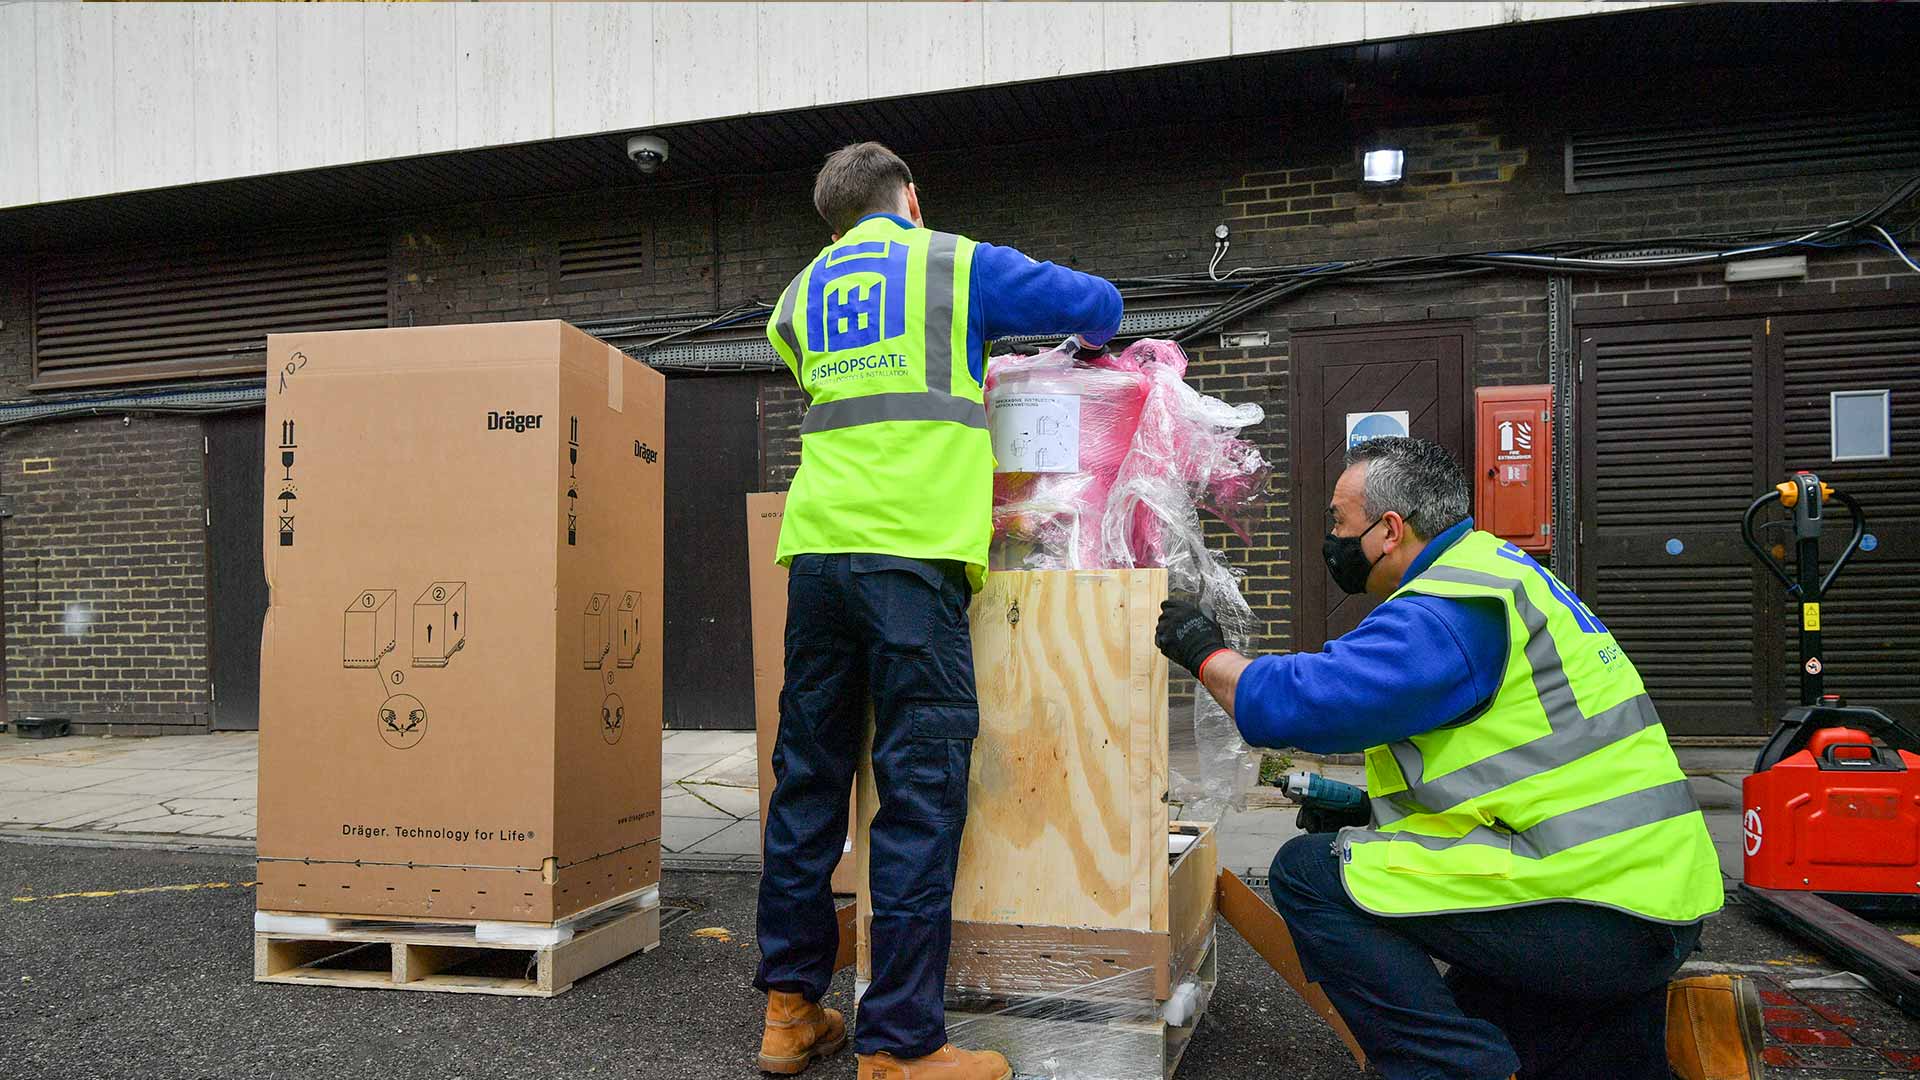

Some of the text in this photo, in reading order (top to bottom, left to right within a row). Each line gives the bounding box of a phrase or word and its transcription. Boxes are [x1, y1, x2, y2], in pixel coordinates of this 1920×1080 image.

[811, 354, 907, 381] BISHOPSGATE
[487, 410, 543, 433] Dräger
[1351, 434, 1368, 442] Fire
[634, 440, 658, 464] Dräger
[342, 824, 389, 838] Dräger.
[395, 826, 470, 841] Technology
[475, 829, 494, 841] for
